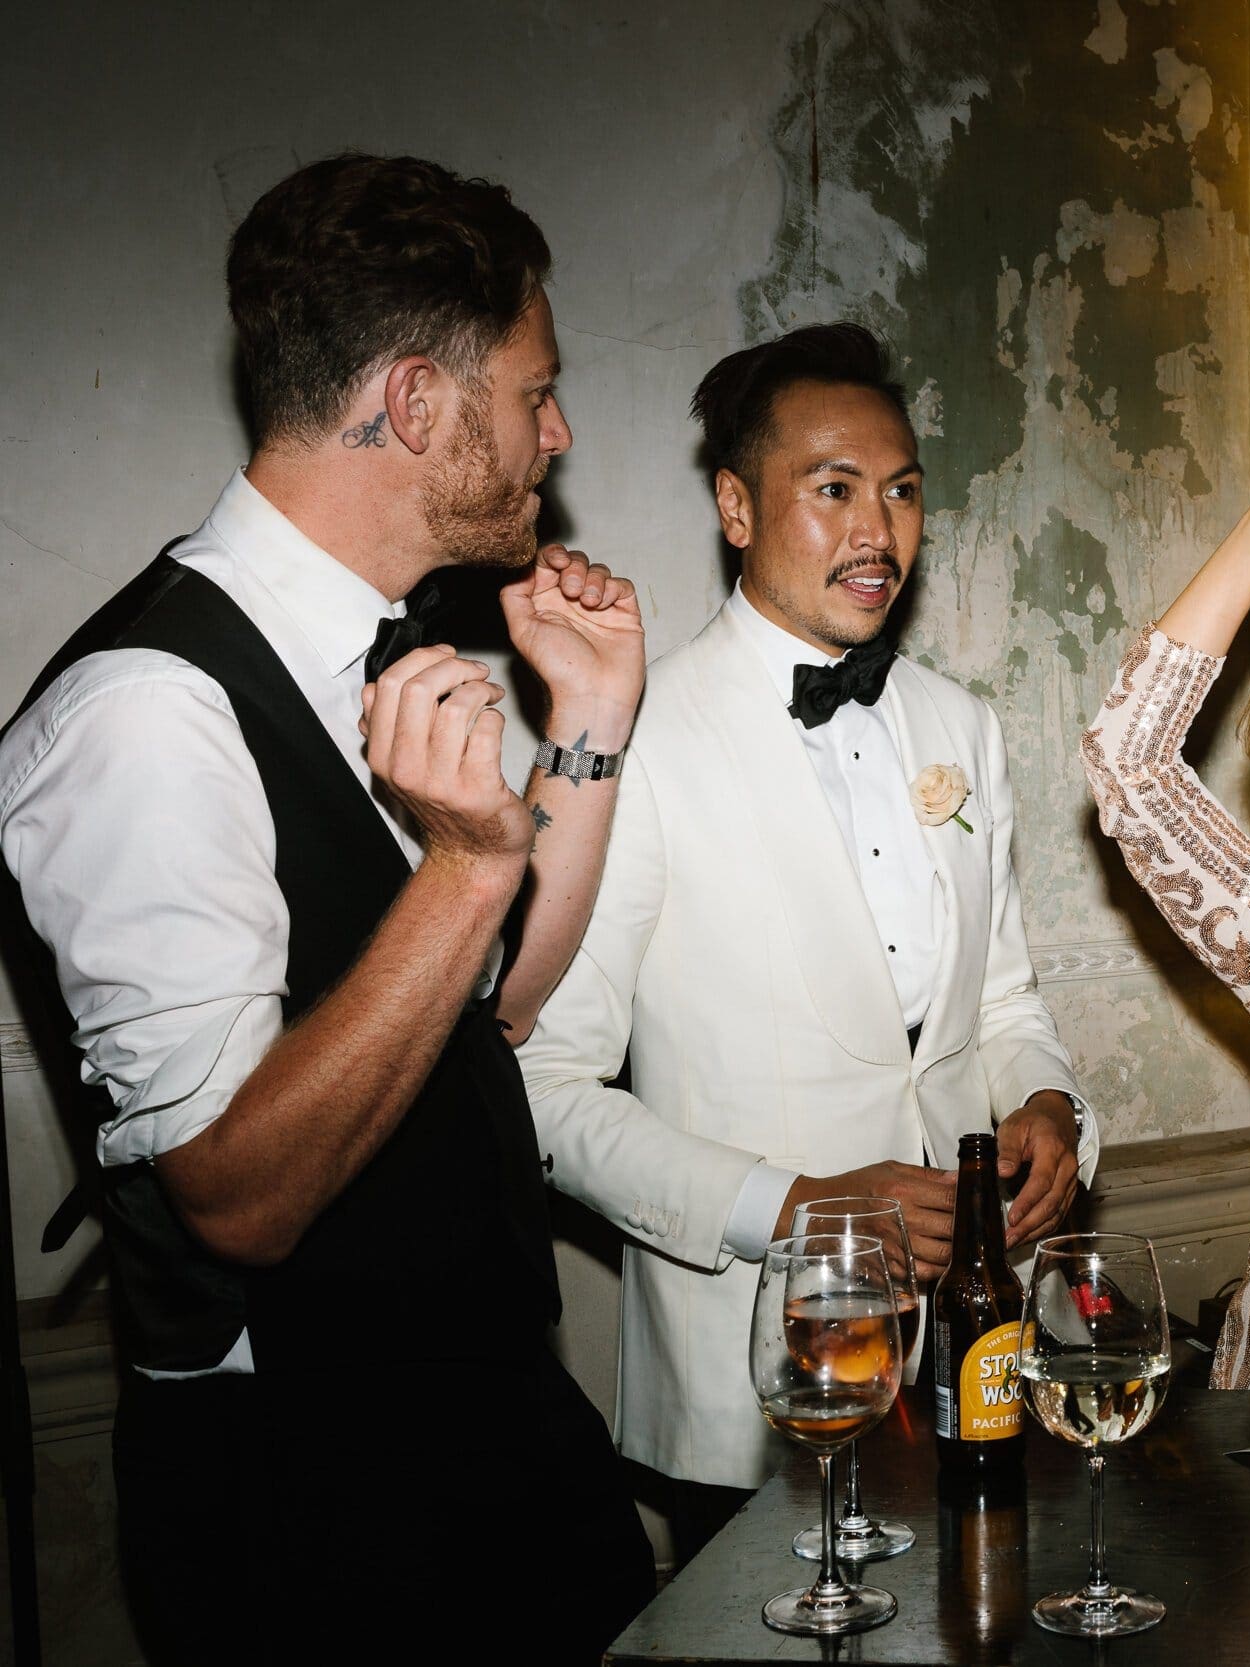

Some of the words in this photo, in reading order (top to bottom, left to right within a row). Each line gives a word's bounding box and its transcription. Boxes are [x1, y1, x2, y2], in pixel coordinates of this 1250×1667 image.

[986, 1336, 1002, 1349] THE
[980, 1382, 1023, 1406] WOO
[972, 1412, 1021, 1429] PACIFIC
